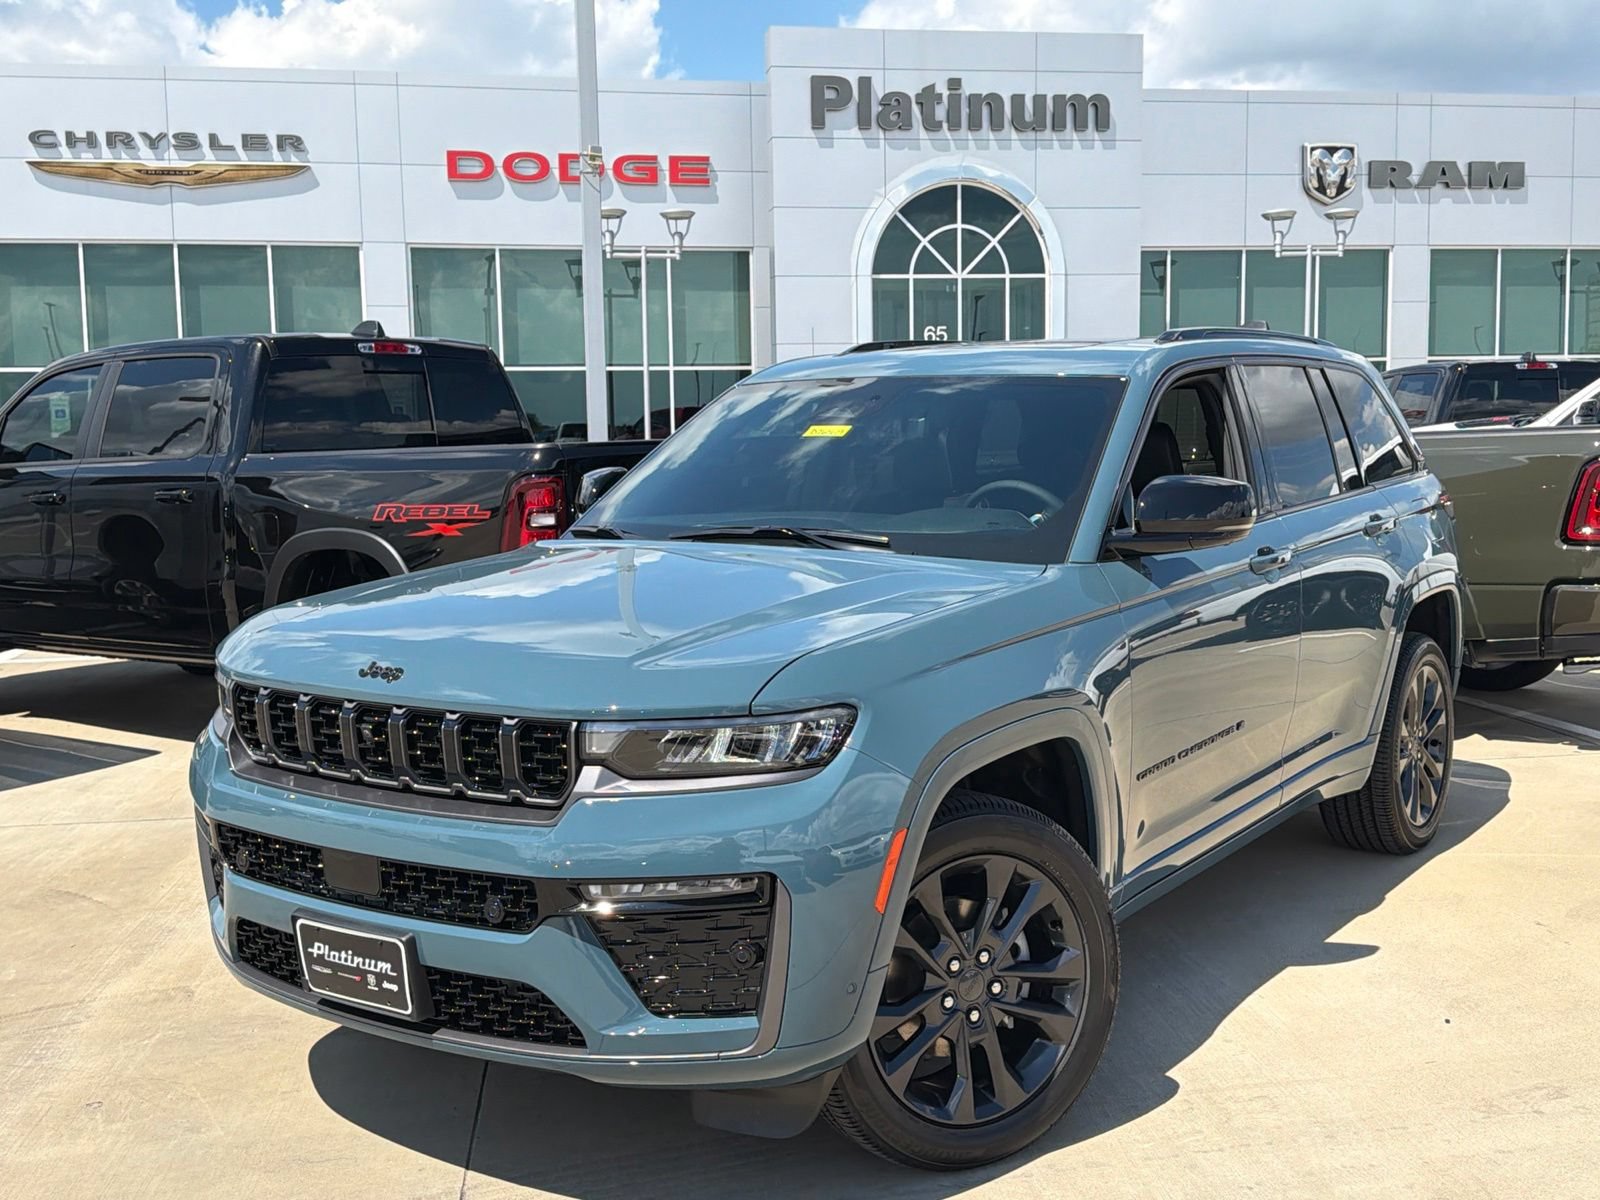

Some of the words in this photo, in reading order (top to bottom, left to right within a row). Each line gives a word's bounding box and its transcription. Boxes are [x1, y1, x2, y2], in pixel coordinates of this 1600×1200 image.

[810, 75, 1110, 132] Platinum
[28, 129, 305, 152] CHRYSLER
[1368, 160, 1525, 189] RAM
[924, 325, 948, 341] 65
[372, 503, 491, 522] REBEL
[358, 661, 405, 684] Jeep
[1177, 724, 1236, 760] CHEROKEE
[1136, 755, 1176, 782] GRAND
[307, 942, 398, 977] Platinum
